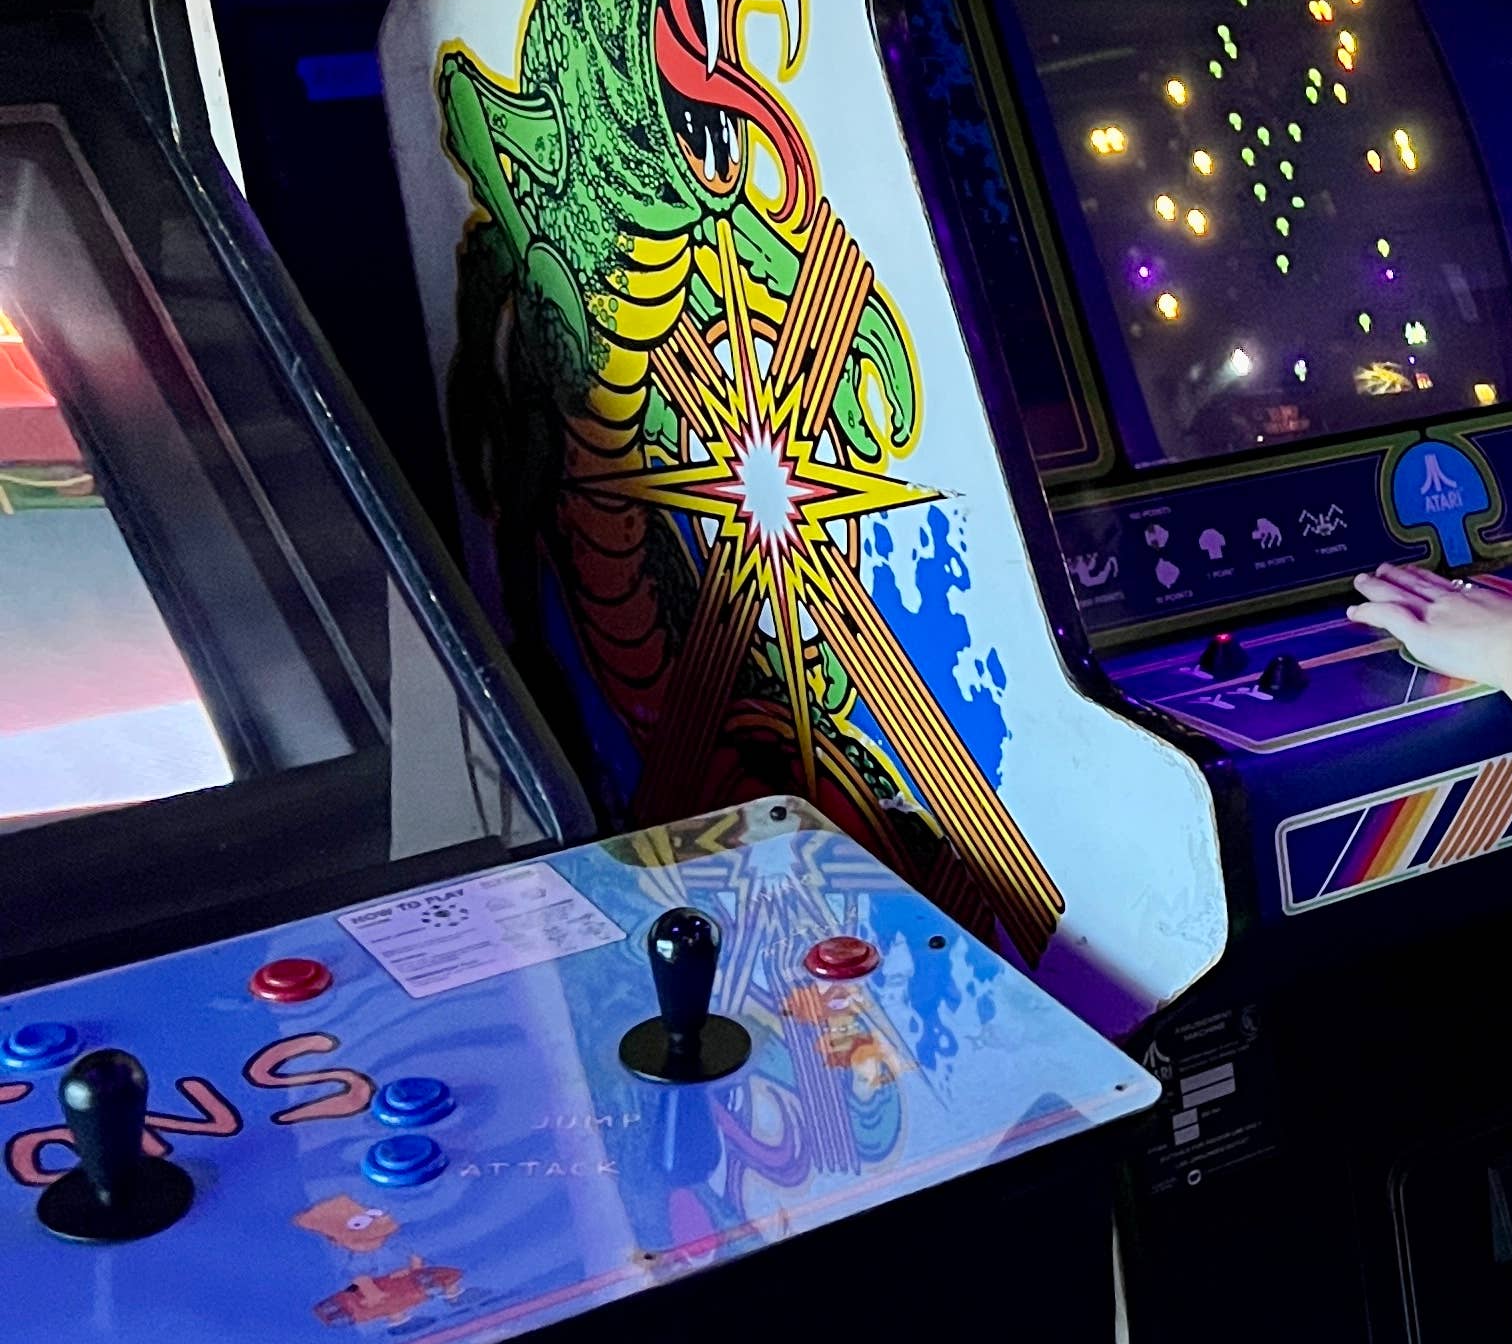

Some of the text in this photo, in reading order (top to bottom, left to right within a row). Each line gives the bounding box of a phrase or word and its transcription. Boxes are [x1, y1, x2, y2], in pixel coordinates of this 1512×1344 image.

[1425, 489, 1463, 513] ATARI
[352, 888, 465, 925] HOW TO PLAY
[531, 1113, 641, 1129] JUMP
[460, 1160, 620, 1177] ATTACK
